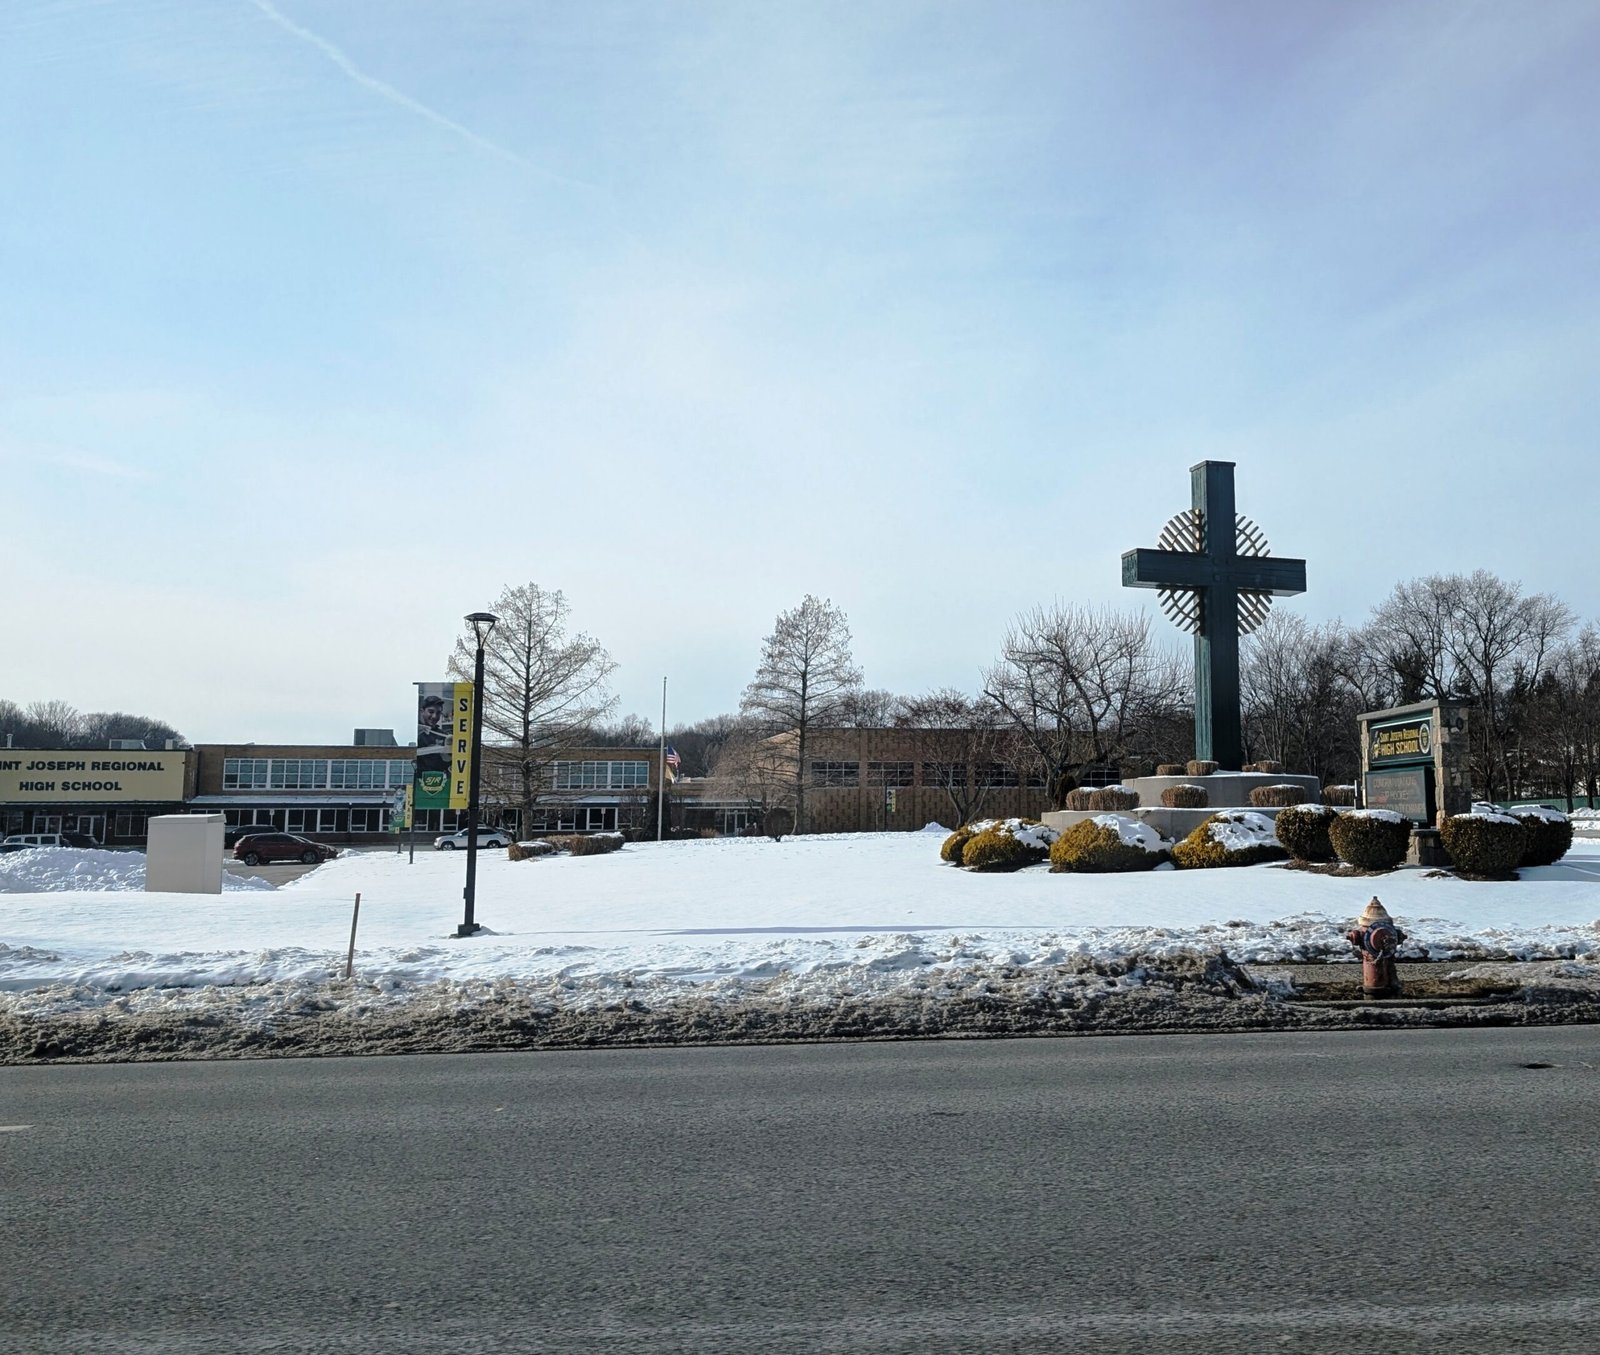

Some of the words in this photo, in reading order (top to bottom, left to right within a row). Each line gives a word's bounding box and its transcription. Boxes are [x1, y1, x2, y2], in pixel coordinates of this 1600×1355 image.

[457, 698, 468, 795] SERVE
[1380, 742, 1395, 755] HIGH
[1395, 740, 1420, 754] SCHOOL
[26, 761, 86, 771] JOSEPH
[91, 761, 165, 771] REGIONAL
[19, 781, 55, 791] HIGH
[61, 781, 122, 791] SCHOOL
